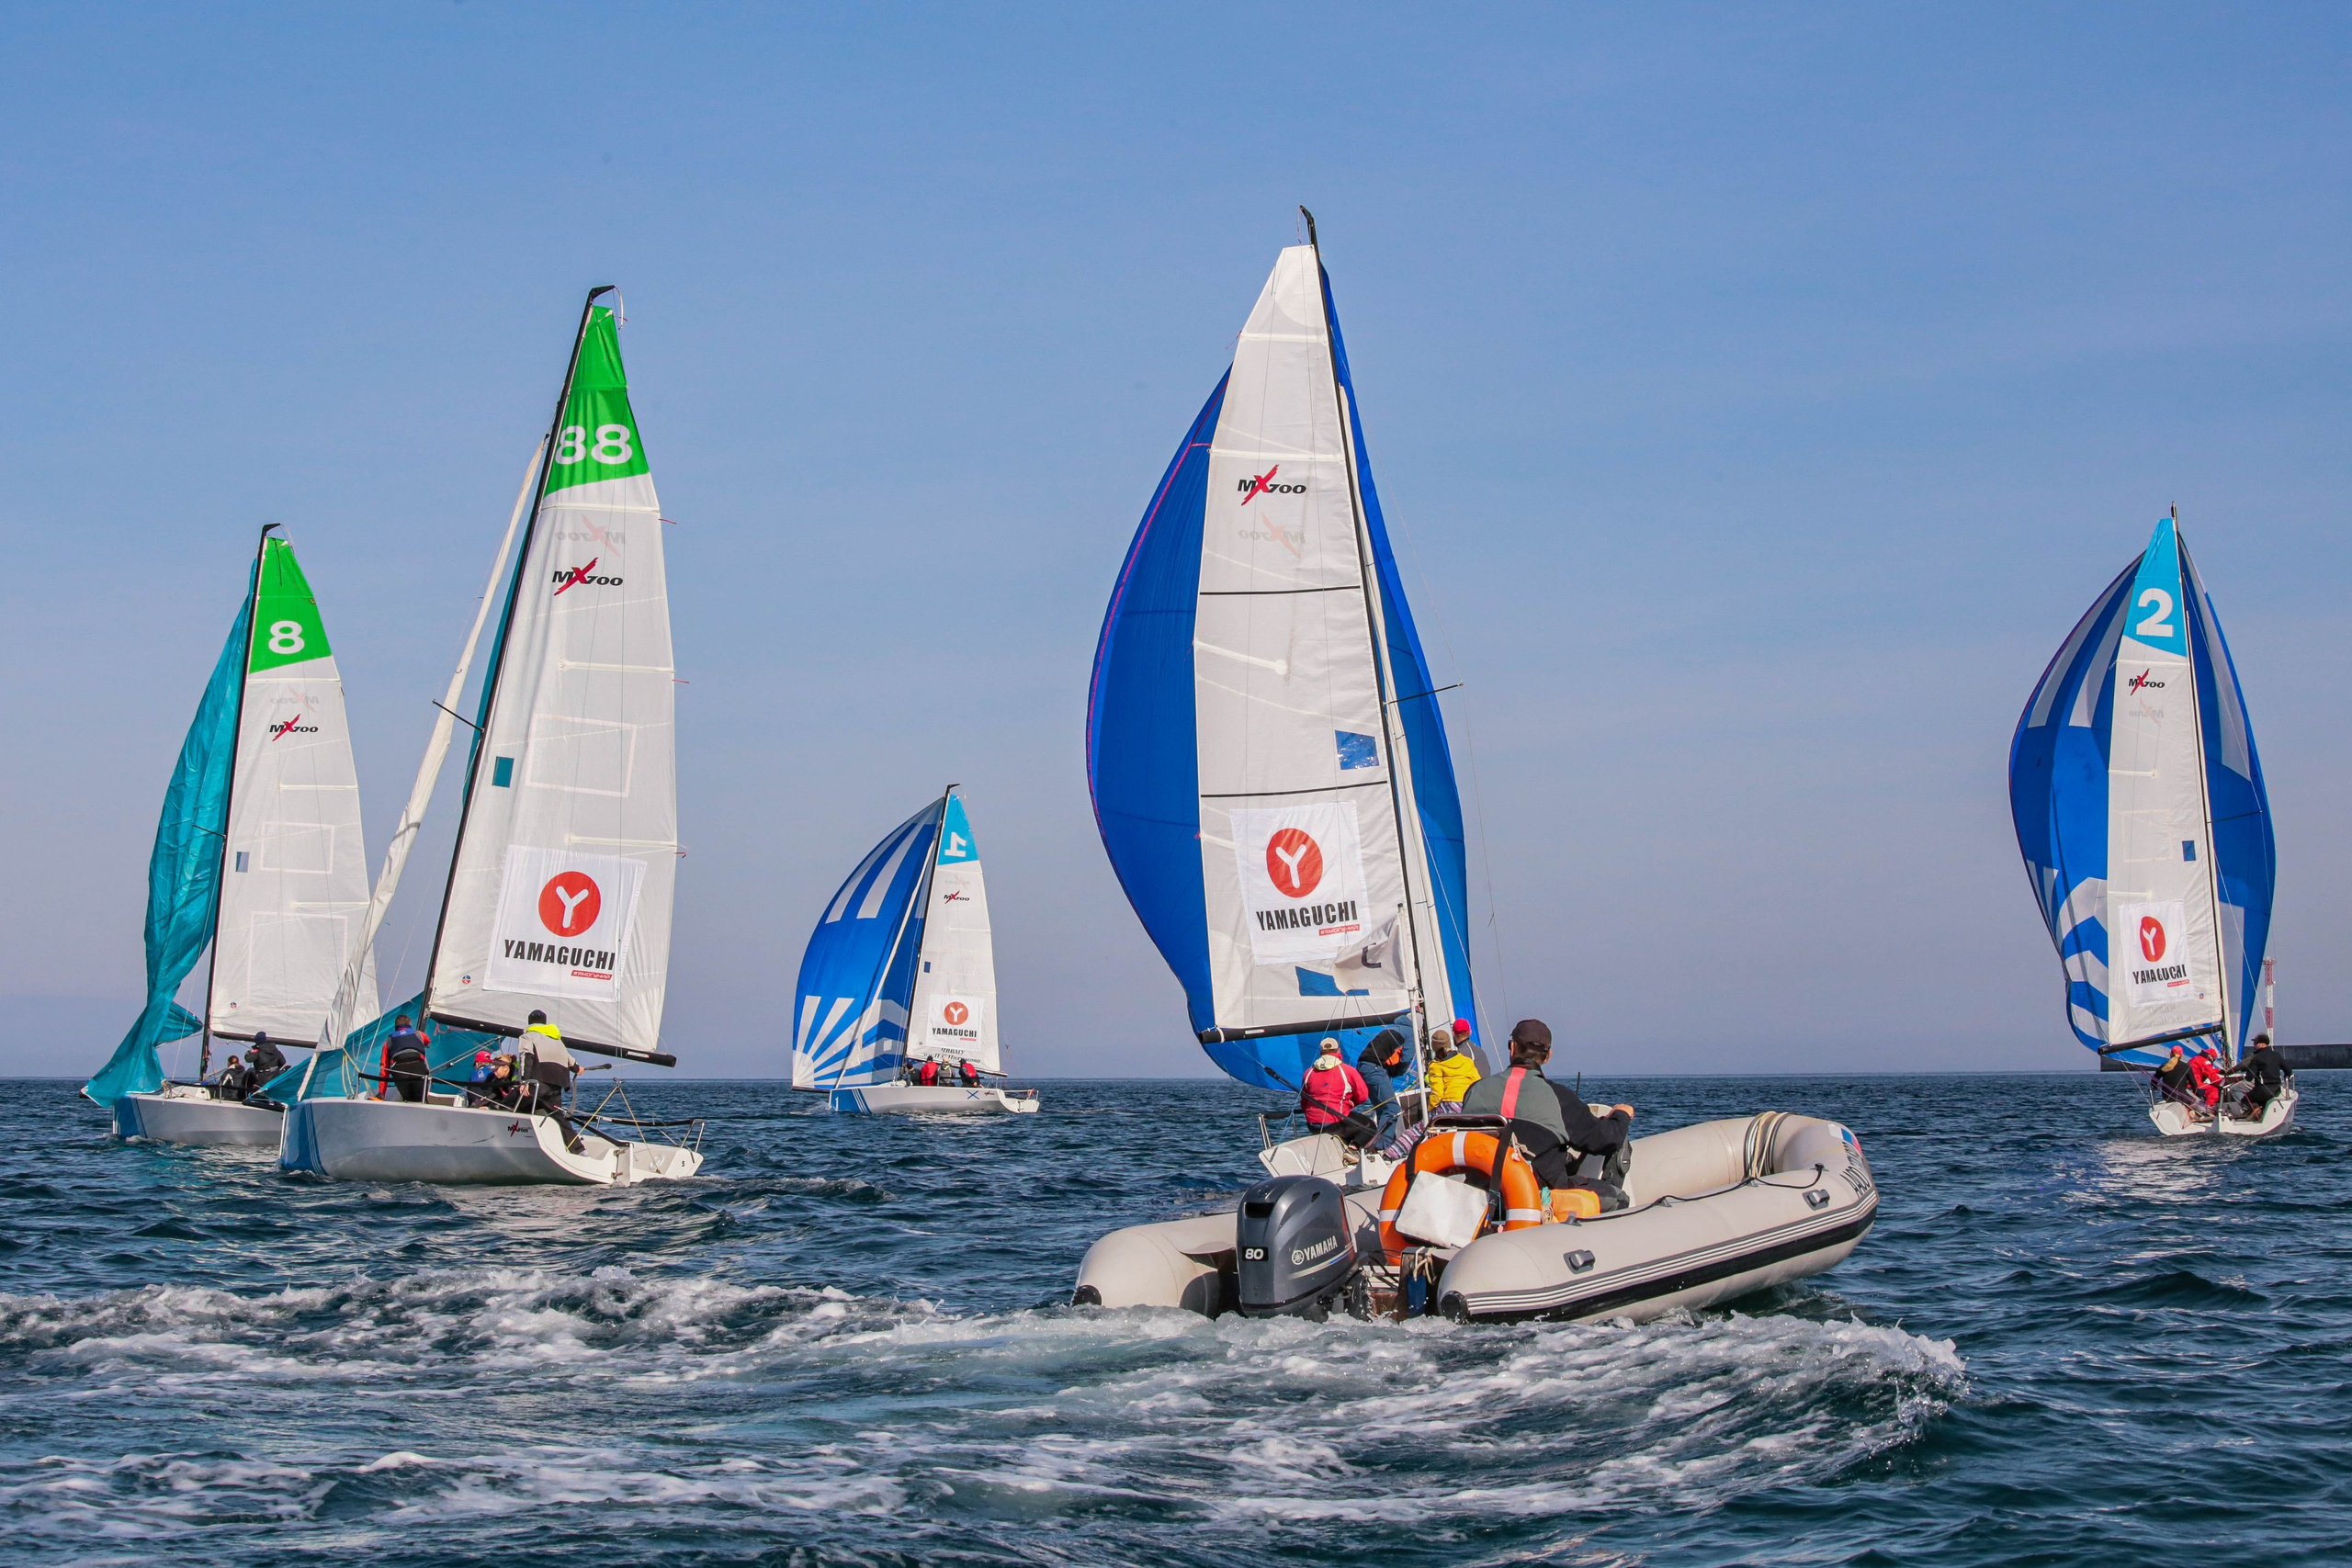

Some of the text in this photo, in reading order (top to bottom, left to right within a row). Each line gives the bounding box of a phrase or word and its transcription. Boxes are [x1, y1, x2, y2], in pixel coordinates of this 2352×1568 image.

[555, 423, 633, 465] 88
[1237, 464, 1306, 506] MX700
[551, 557, 623, 596] MX700
[2136, 588, 2174, 637] 2
[268, 620, 305, 654] 8
[2128, 668, 2165, 696] MX700
[269, 714, 318, 741] MX700
[1275, 844, 1306, 889] Y
[556, 886, 589, 929] Y
[1256, 900, 1358, 931] YAMAGUCHI
[504, 939, 616, 971] YAMAGUCHI
[2143, 927, 2156, 955] Y
[950, 1007, 963, 1022] Y
[932, 1027, 977, 1038] YAMAGUCHI
[1245, 1248, 1263, 1259] 80
[1304, 1235, 1338, 1261] YAMAHA
